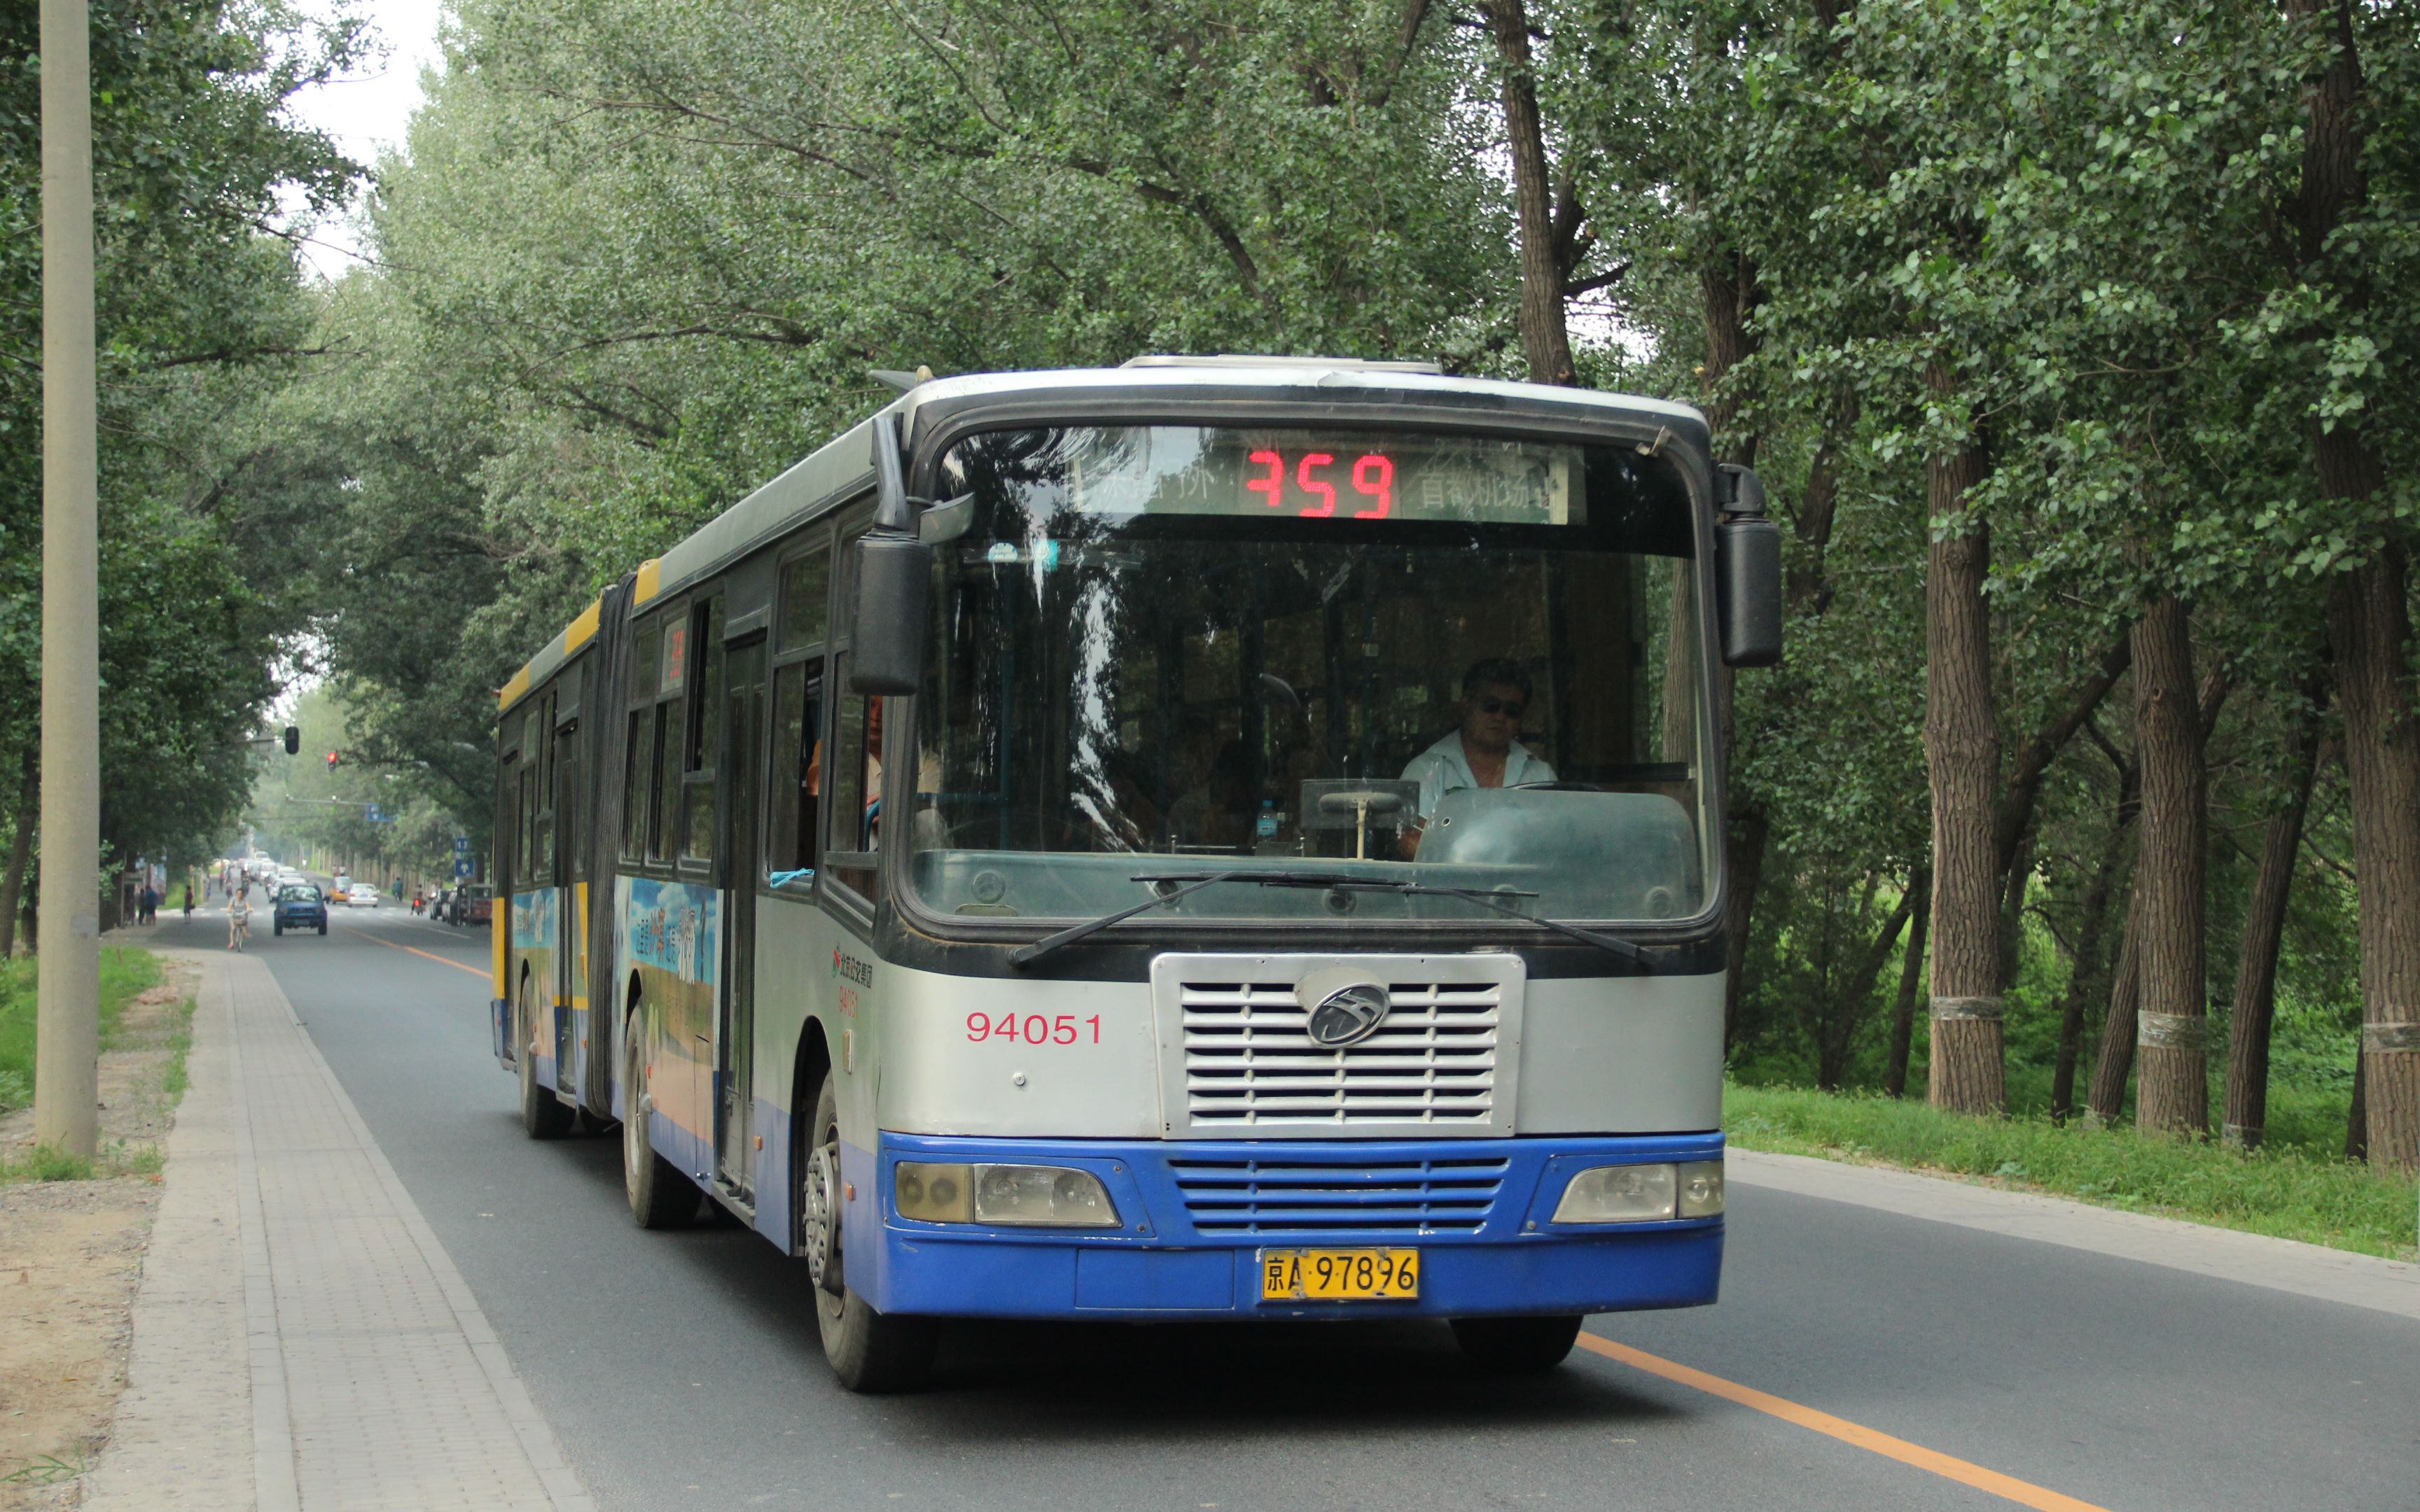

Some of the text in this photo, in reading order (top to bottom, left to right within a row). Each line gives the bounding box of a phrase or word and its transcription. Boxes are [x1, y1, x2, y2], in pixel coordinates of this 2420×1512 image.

[1246, 450, 1393, 519] 359
[840, 953, 873, 989] 北京公交集团
[840, 986, 858, 1018] 94051
[966, 1011, 1100, 1045] 94051
